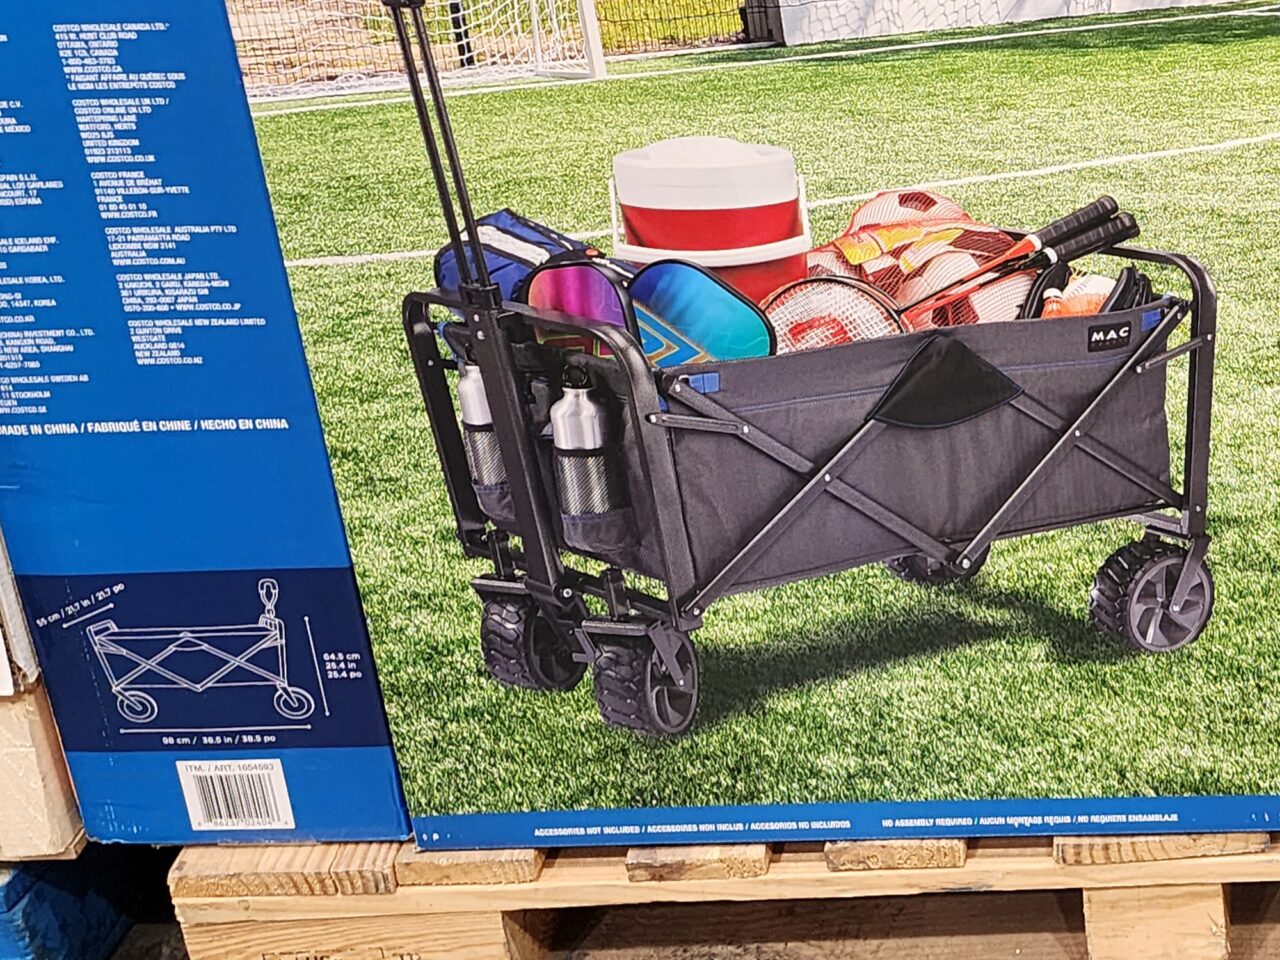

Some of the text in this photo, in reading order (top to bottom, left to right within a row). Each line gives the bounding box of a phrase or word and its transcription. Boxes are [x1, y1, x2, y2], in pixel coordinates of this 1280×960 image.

[1091, 327, 1129, 342] MAC
[0, 418, 289, 435] MADE IN CHINA FABRIQUÉ EN CHINE HECHO EN CHINA
[36, 583, 125, 627] 55 cm 21.7 in 21.7 po
[349, 671, 362, 679] po
[223, 736, 233, 744] in
[263, 736, 276, 744] po
[185, 765, 203, 773] ITM.
[214, 764, 235, 772] ART.
[534, 826, 640, 837] ACCESSORIES NOT INCLUDED
